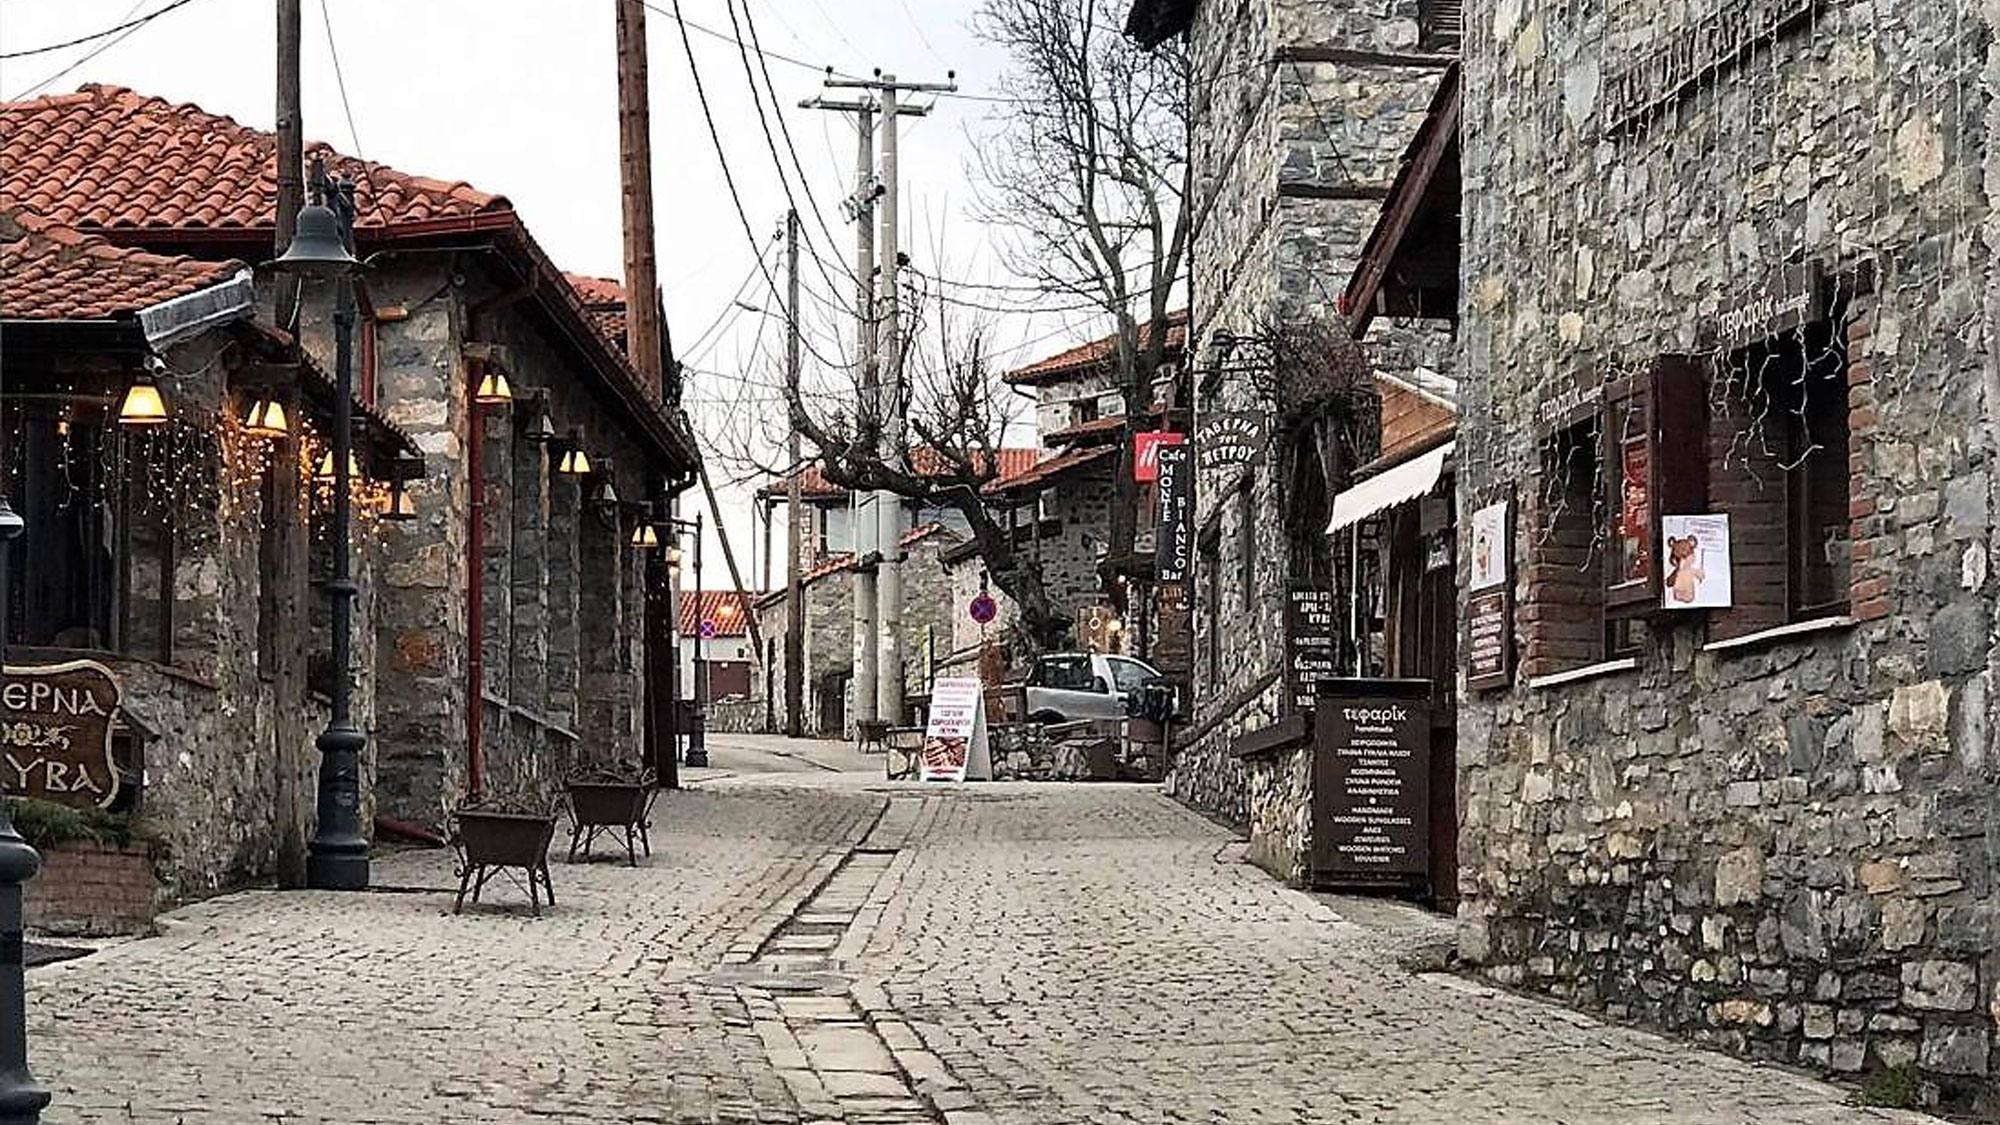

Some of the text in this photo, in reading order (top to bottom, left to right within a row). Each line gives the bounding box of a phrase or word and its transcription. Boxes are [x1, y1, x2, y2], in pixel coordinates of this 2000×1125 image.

[1159, 449, 1186, 461] Cafe
[1201, 445, 1257, 466] ΠΕΤΡΟΥ
[1160, 464, 1174, 522] MONTE
[1174, 497, 1187, 569] BIANCO
[1162, 570, 1183, 580] Bar
[3, 752, 103, 795] ΥΒΑ
